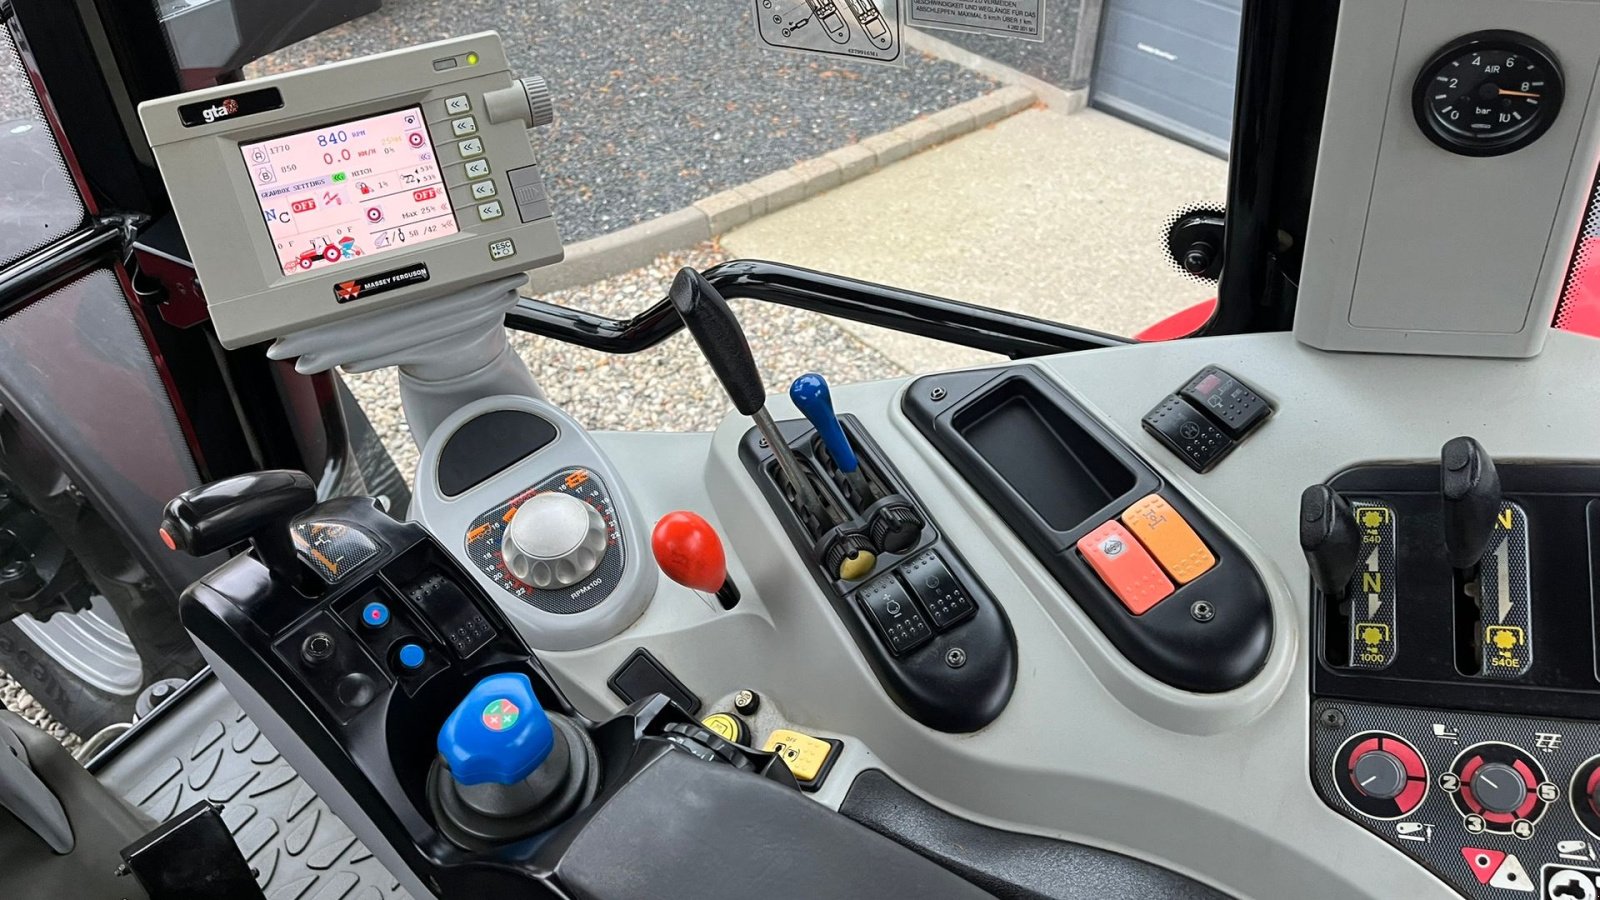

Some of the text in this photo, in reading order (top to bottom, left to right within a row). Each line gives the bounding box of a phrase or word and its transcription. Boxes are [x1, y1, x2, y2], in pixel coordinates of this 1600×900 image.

[1472, 56, 1481, 66] 4
[1506, 57, 1515, 68] 6
[1484, 65, 1501, 74] AIR
[1449, 78, 1459, 89] 2
[1521, 81, 1530, 91] 8
[202, 104, 229, 123] gta
[1450, 110, 1459, 120] 0
[1475, 106, 1492, 115] bar
[1498, 112, 1511, 123] 10
[317, 130, 348, 147] 840
[255, 144, 291, 160] A 1770
[323, 148, 352, 165] 0.0
[262, 172, 270, 180] B
[351, 167, 373, 178] HITCH
[261, 179, 326, 199] GEARBOX SETTINGS
[414, 190, 436, 201] OFF
[293, 200, 316, 212] OFF
[265, 208, 291, 223] N C
[402, 211, 418, 219] Max
[495, 241, 511, 251] ESC
[364, 268, 427, 289] MASSEY FERGUSON
[1495, 509, 1512, 529] N
[493, 572, 503, 581] 20
[1362, 572, 1382, 593] N
[570, 577, 603, 600] RPMx100
[1360, 653, 1384, 662] 1000
[1491, 658, 1521, 668] 540E
[1442, 775, 1457, 790] 2
[1541, 785, 1556, 800] 5
[1468, 816, 1482, 831] 3
[1515, 822, 1531, 837] 4
